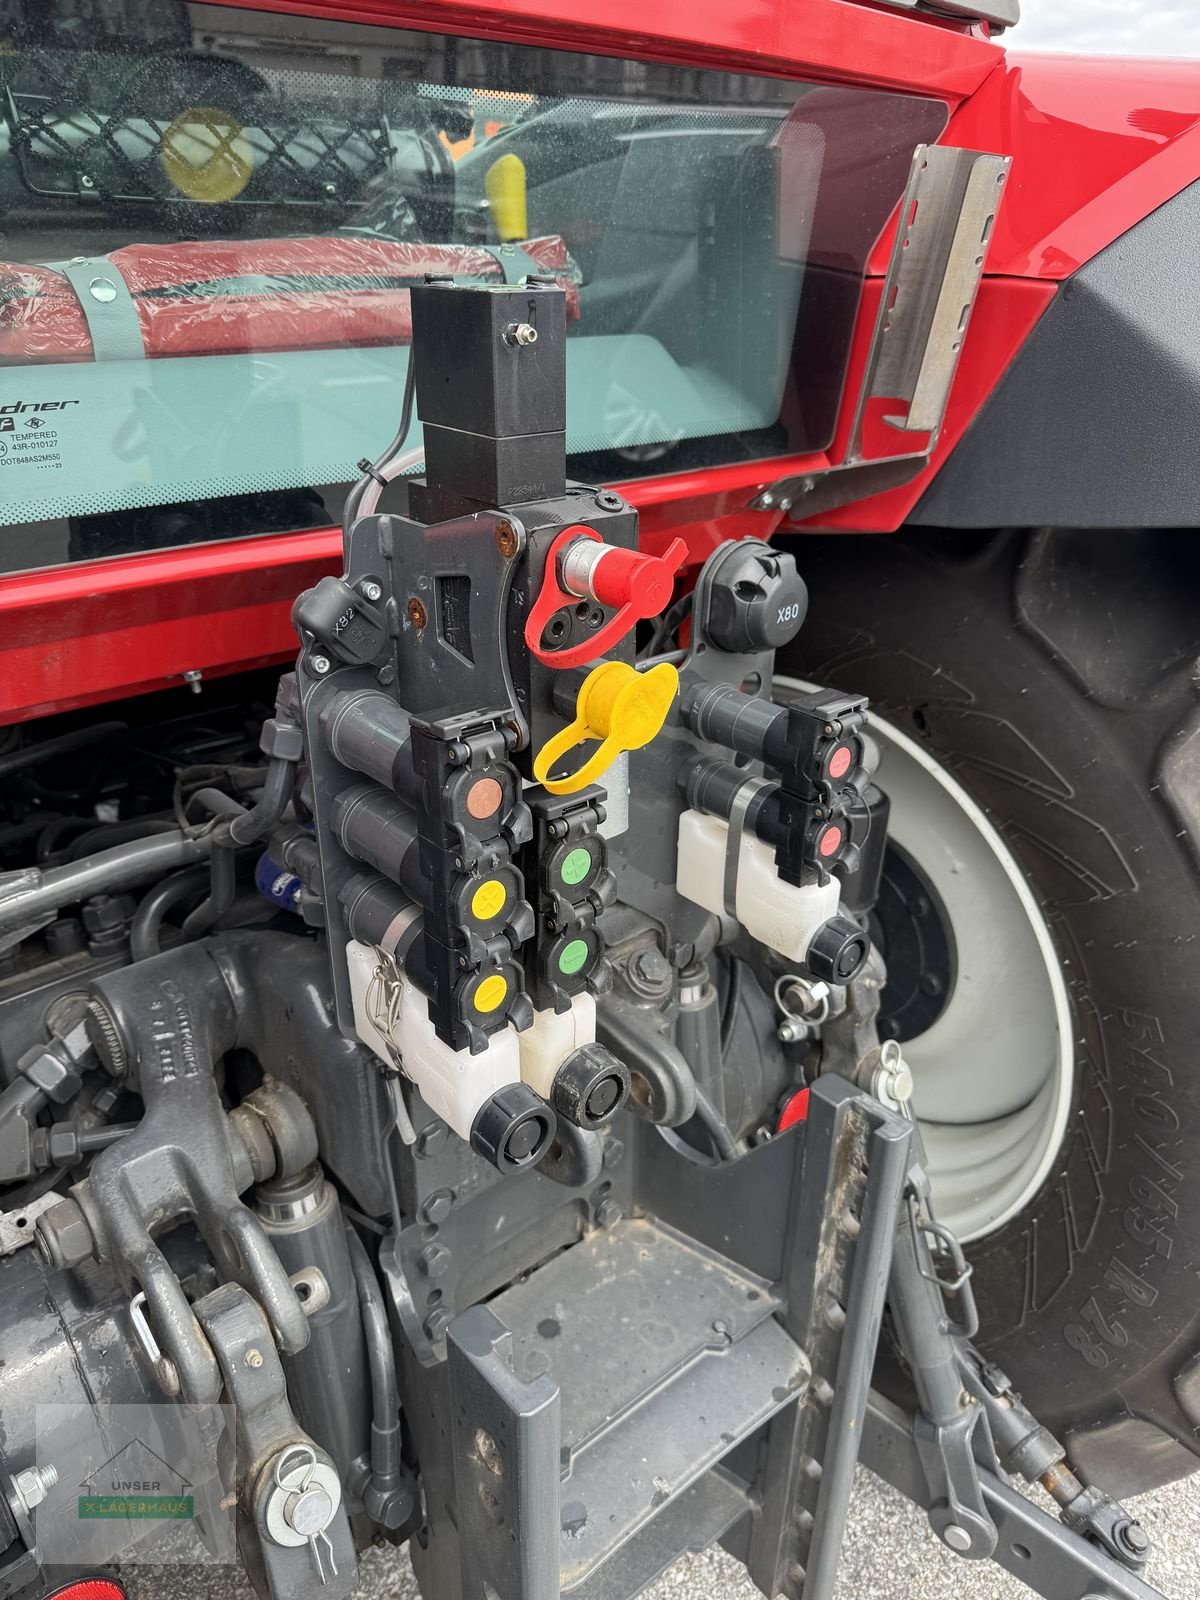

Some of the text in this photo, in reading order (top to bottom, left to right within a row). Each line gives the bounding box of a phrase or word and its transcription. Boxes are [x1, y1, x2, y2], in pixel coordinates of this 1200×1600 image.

[10, 431, 57, 441] TEMPERED
[12, 440, 58, 451] 43R-010127
[333, 607, 355, 636] X82
[776, 603, 799, 624] X80
